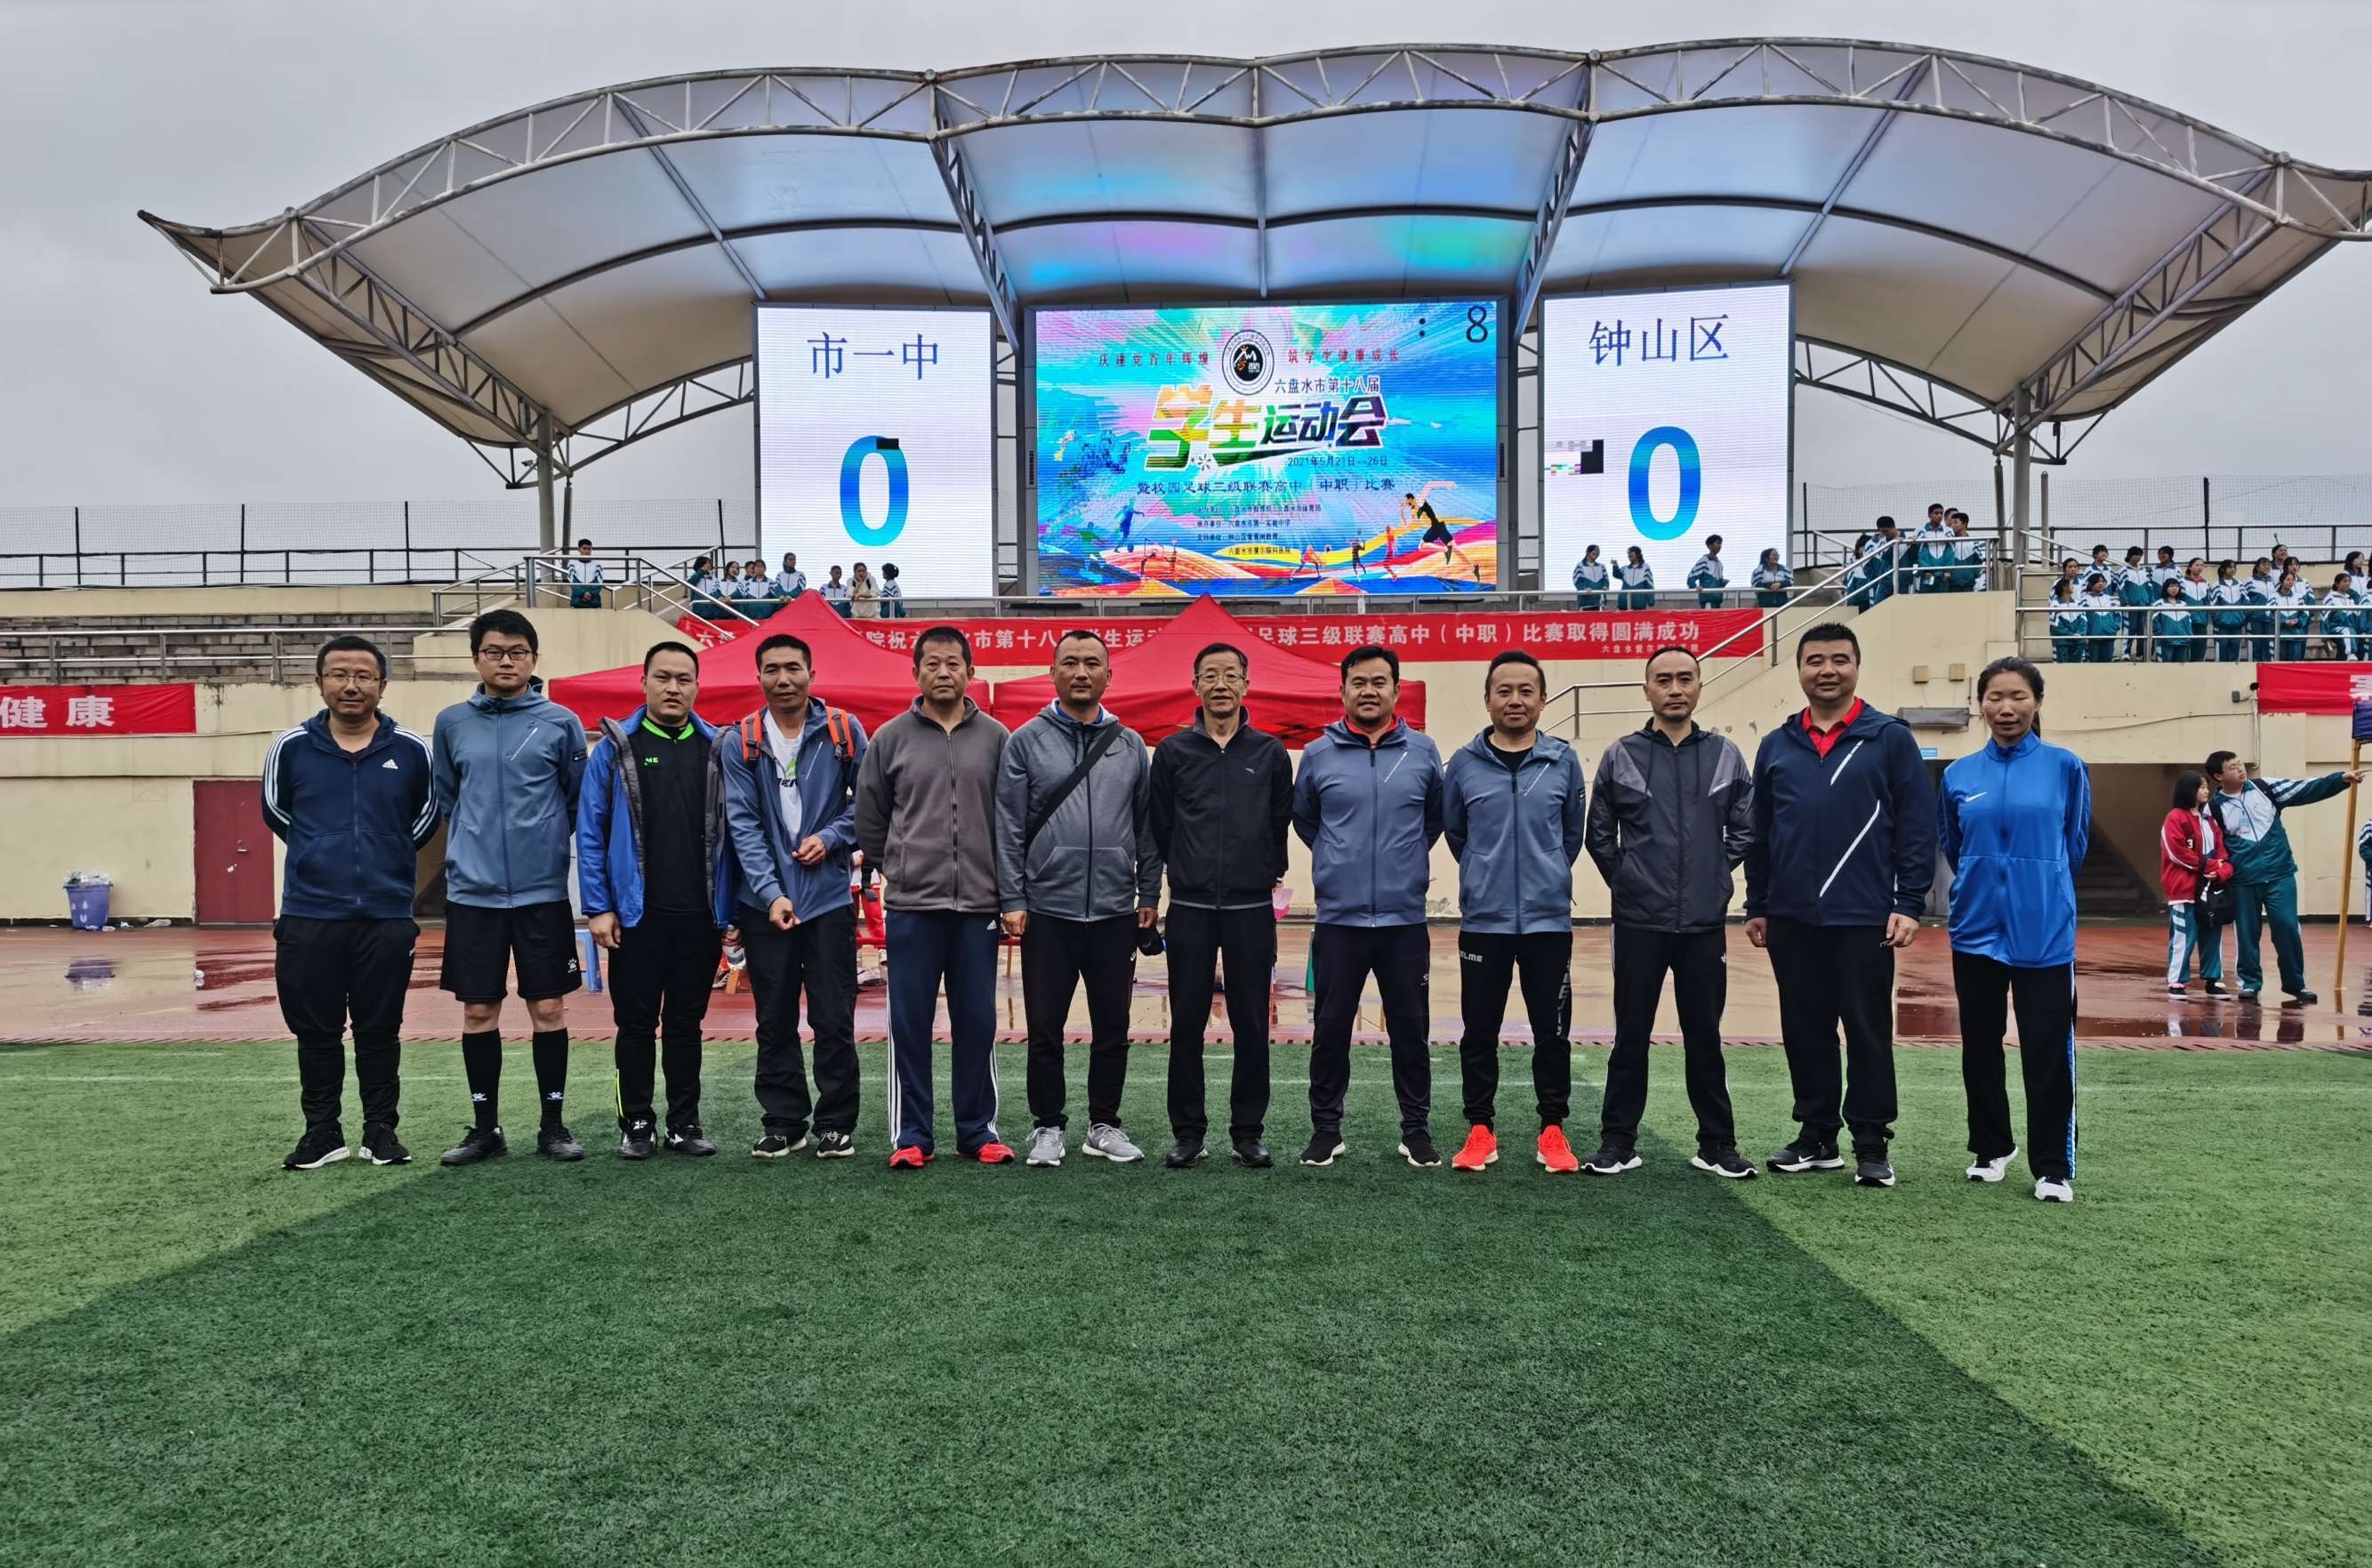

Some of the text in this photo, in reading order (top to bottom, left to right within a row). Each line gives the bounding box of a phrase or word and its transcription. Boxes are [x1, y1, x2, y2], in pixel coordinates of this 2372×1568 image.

[1466, 306, 1488, 343] 8
[1588, 314, 1729, 366] 钟山区
[807, 331, 938, 381] 市一中
[1288, 348, 1399, 363] 筑学生健康成长
[1274, 377, 1380, 393] 六盘水市第十八届
[1145, 383, 1387, 469] 学生运动会
[840, 435, 909, 547] 0
[1628, 426, 1701, 541] 0
[0, 695, 115, 728] 健康
